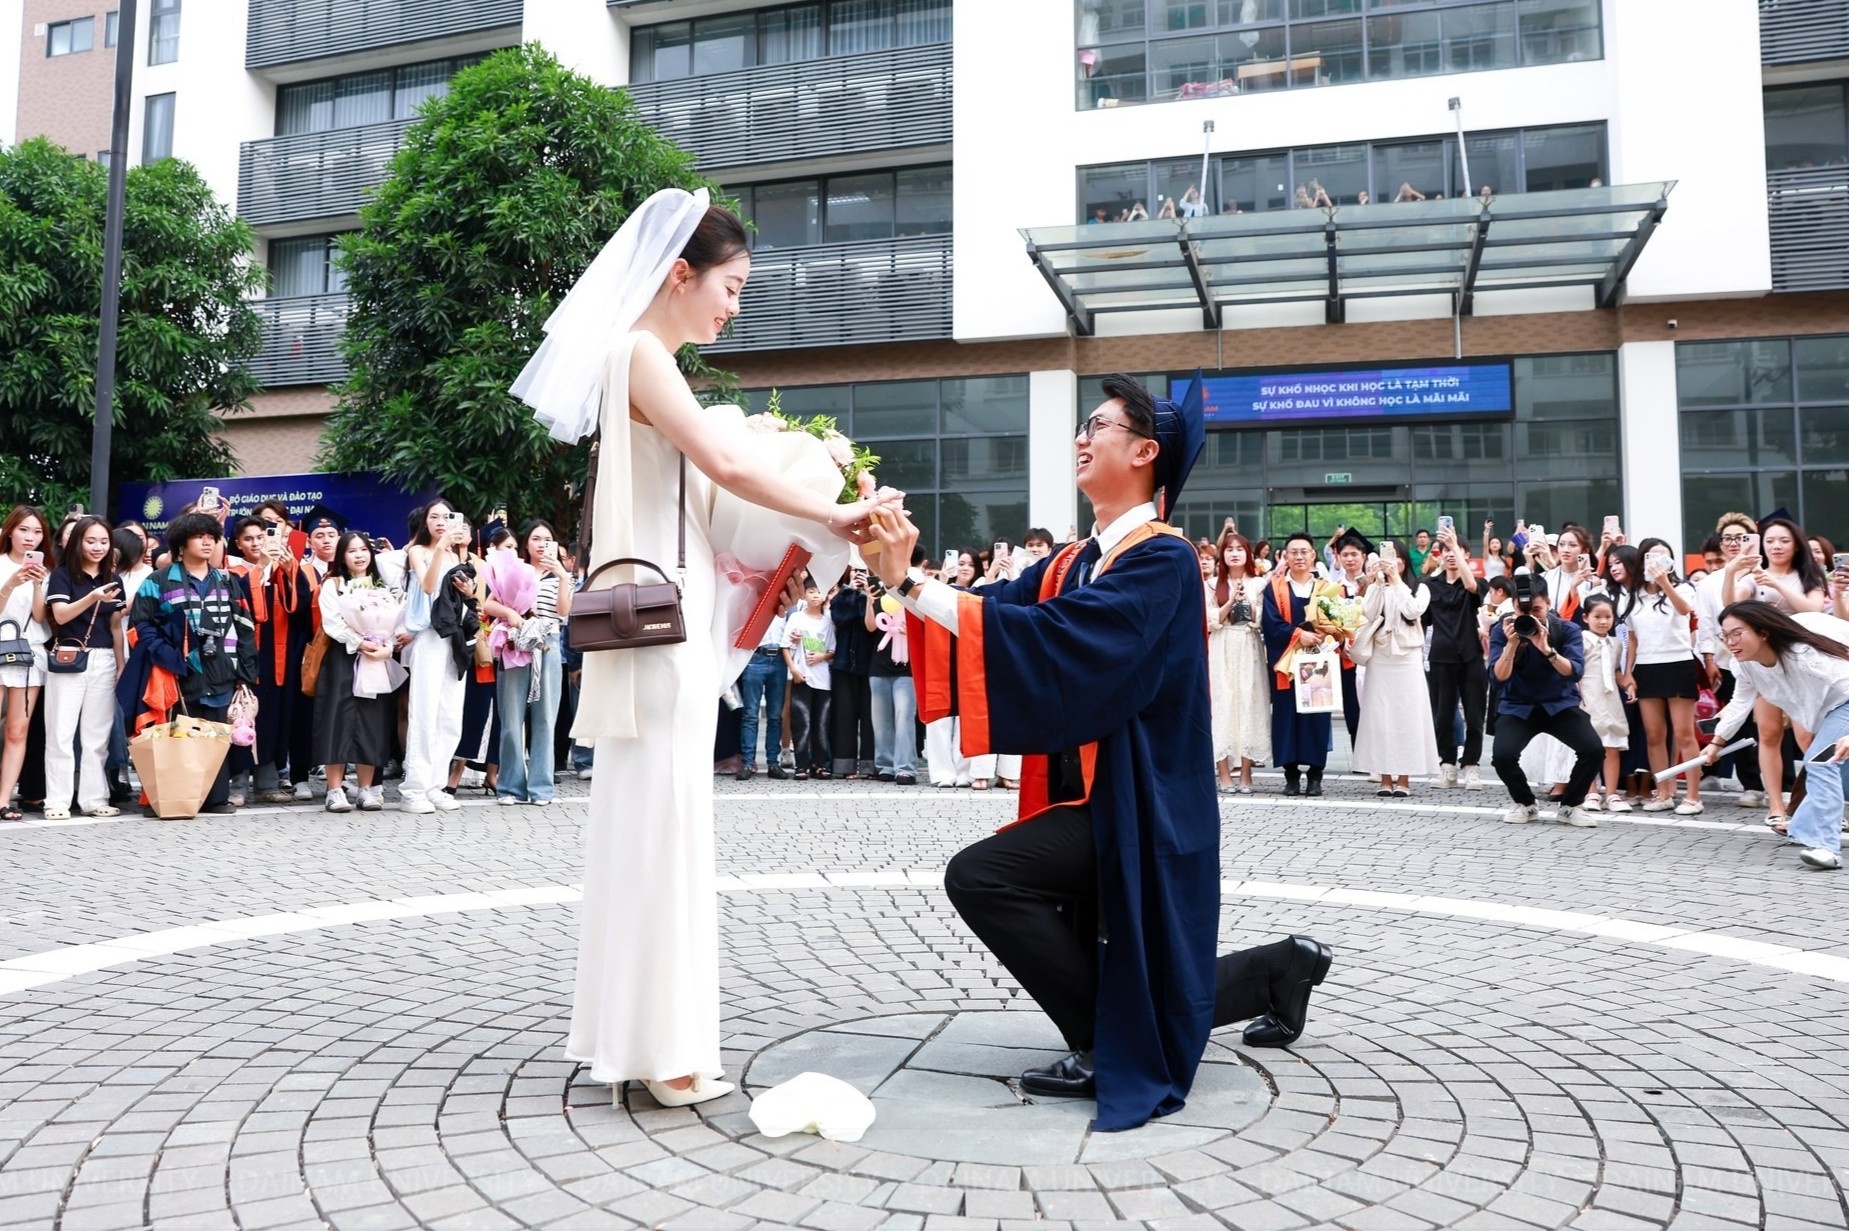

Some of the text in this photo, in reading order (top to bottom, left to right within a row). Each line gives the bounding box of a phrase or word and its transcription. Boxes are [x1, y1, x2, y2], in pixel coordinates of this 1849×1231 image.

[1261, 385, 1277, 397] SỰ
[1304, 383, 1337, 396] NHỌC
[1339, 382, 1359, 392] KHI
[1360, 381, 1386, 393] HỌC
[1387, 378, 1403, 390] LÀ
[1404, 379, 1430, 391] TẠM
[1252, 400, 1268, 412] SỰ
[1296, 400, 1320, 409] ĐAU
[1322, 396, 1335, 408] VÌ
[1336, 395, 1377, 408] KHÔNG
[1378, 396, 1403, 408] HỌC
[1405, 393, 1421, 405] LÀ
[1423, 391, 1445, 404] MÃI
[1447, 390, 1470, 403] MÃI
[229, 493, 241, 505] BỘ
[241, 492, 260, 504] GIÁO
[277, 491, 288, 502] VÀ
[289, 490, 307, 502] ĐÀO
[306, 491, 323, 503] TẠO
[290, 505, 305, 516] ĐẠI
